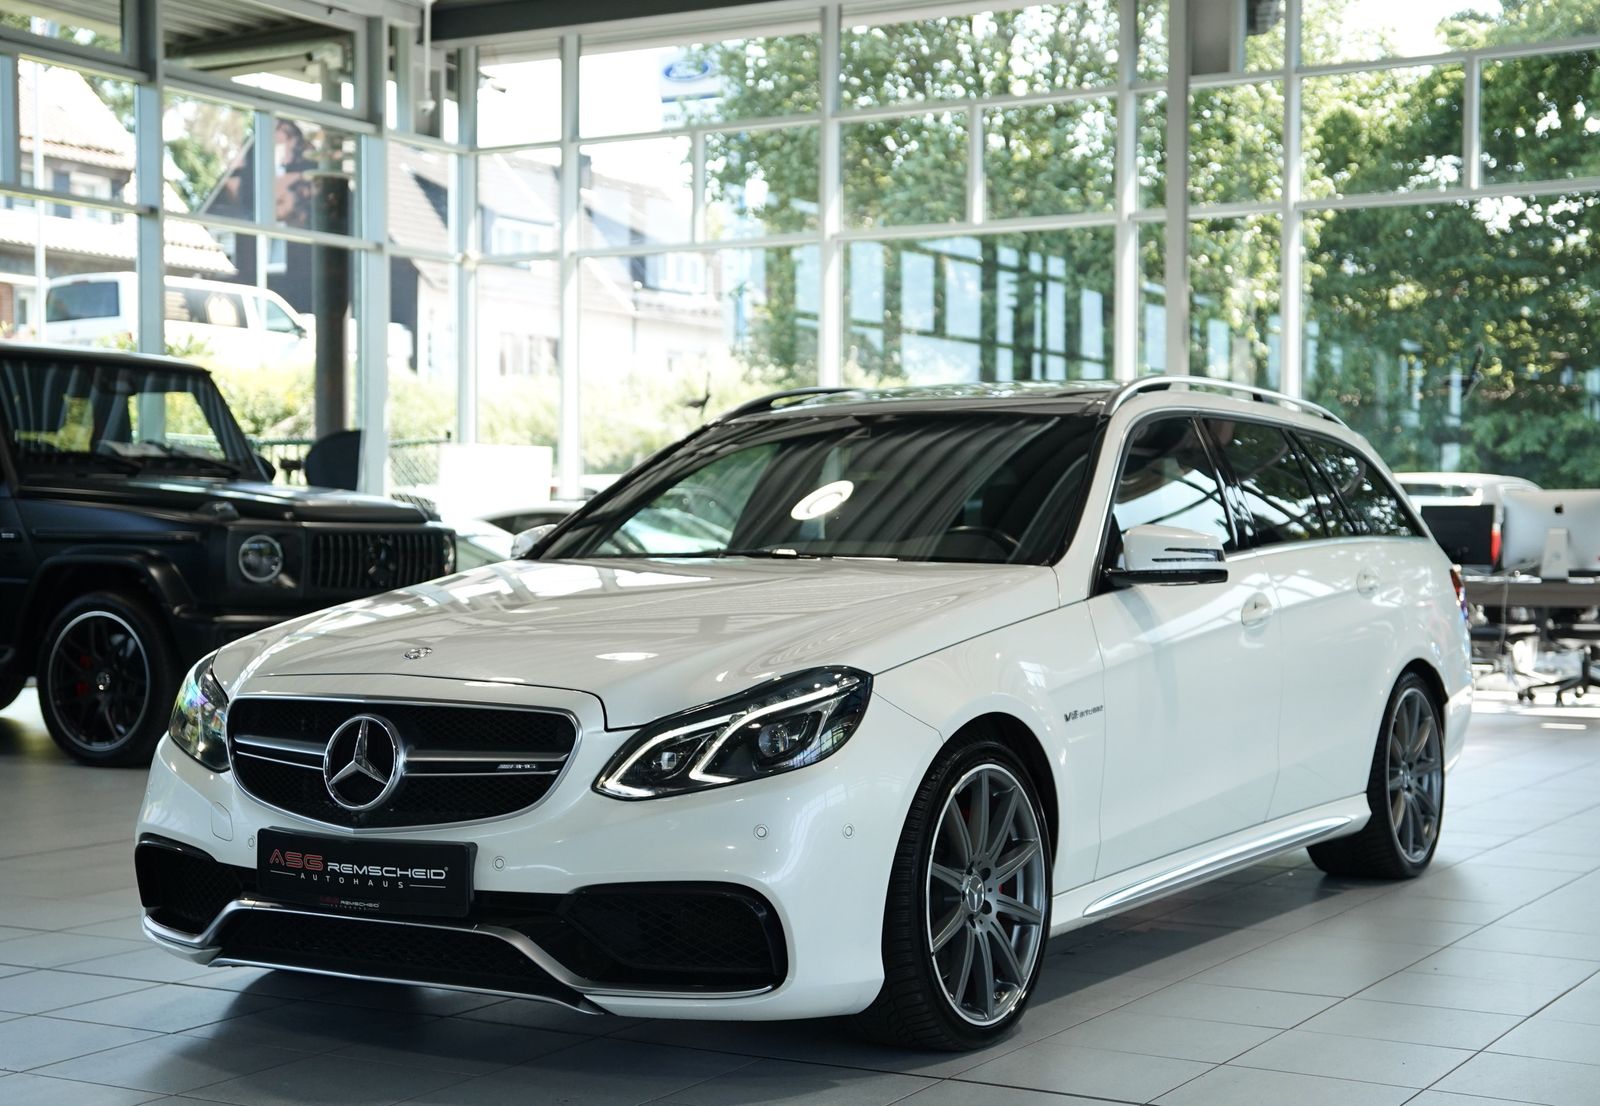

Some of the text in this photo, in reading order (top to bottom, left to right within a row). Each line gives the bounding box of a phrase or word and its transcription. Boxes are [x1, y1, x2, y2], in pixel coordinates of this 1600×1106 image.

[269, 848, 446, 880] ASG REMSCHEID
[300, 872, 404, 889] AUTOHAUS
